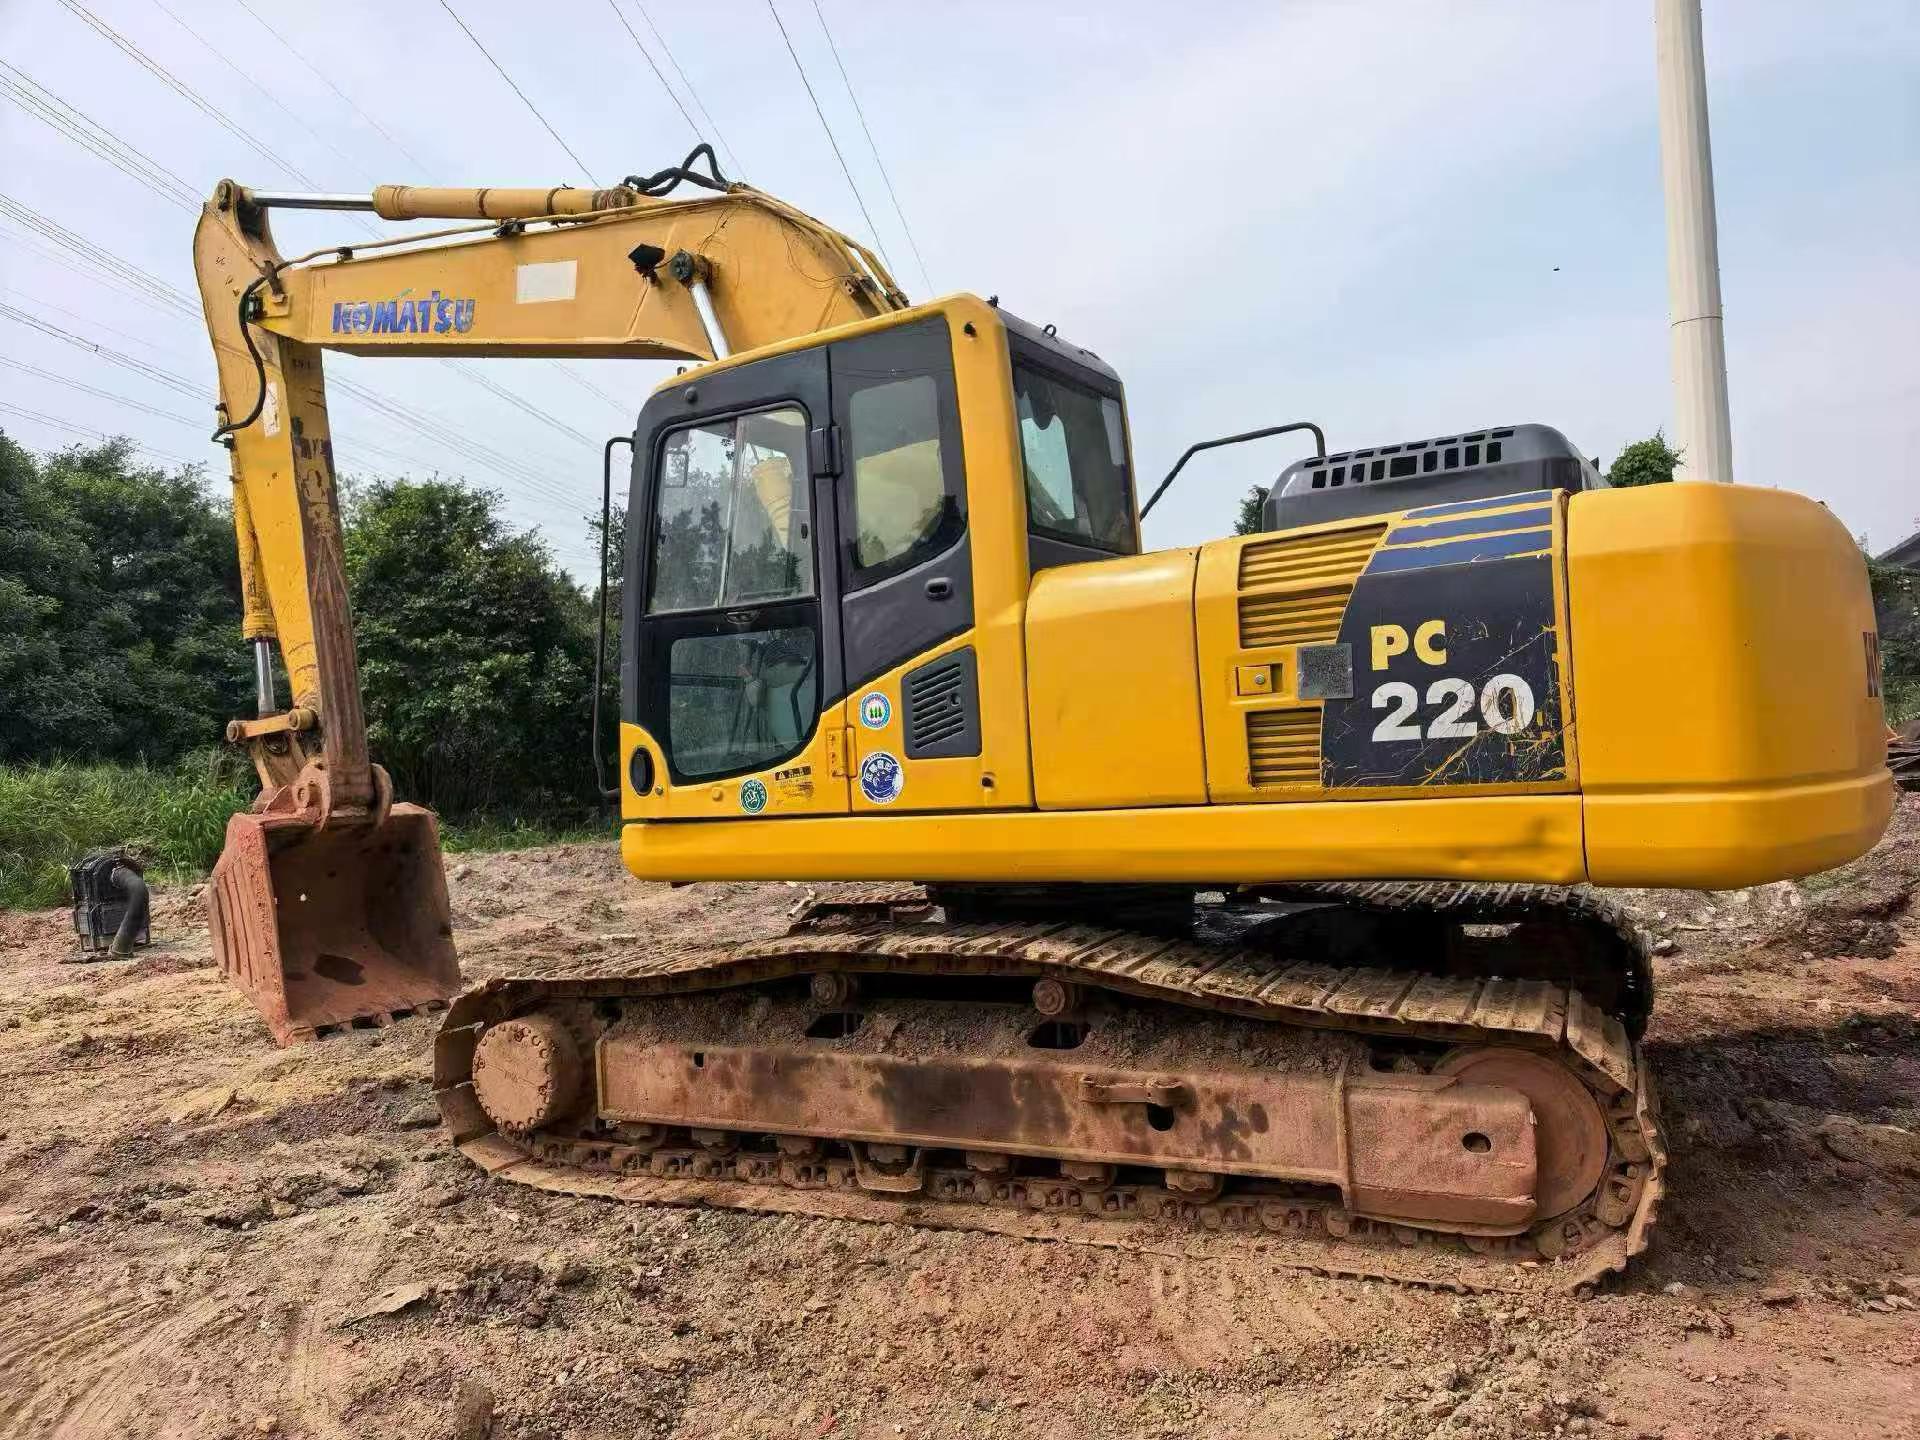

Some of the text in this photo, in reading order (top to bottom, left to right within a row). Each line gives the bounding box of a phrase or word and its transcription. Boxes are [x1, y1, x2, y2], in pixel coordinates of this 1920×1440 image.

[332, 291, 475, 334] KOMATSU
[1371, 620, 1447, 671] PC
[1372, 673, 1535, 742] 220
